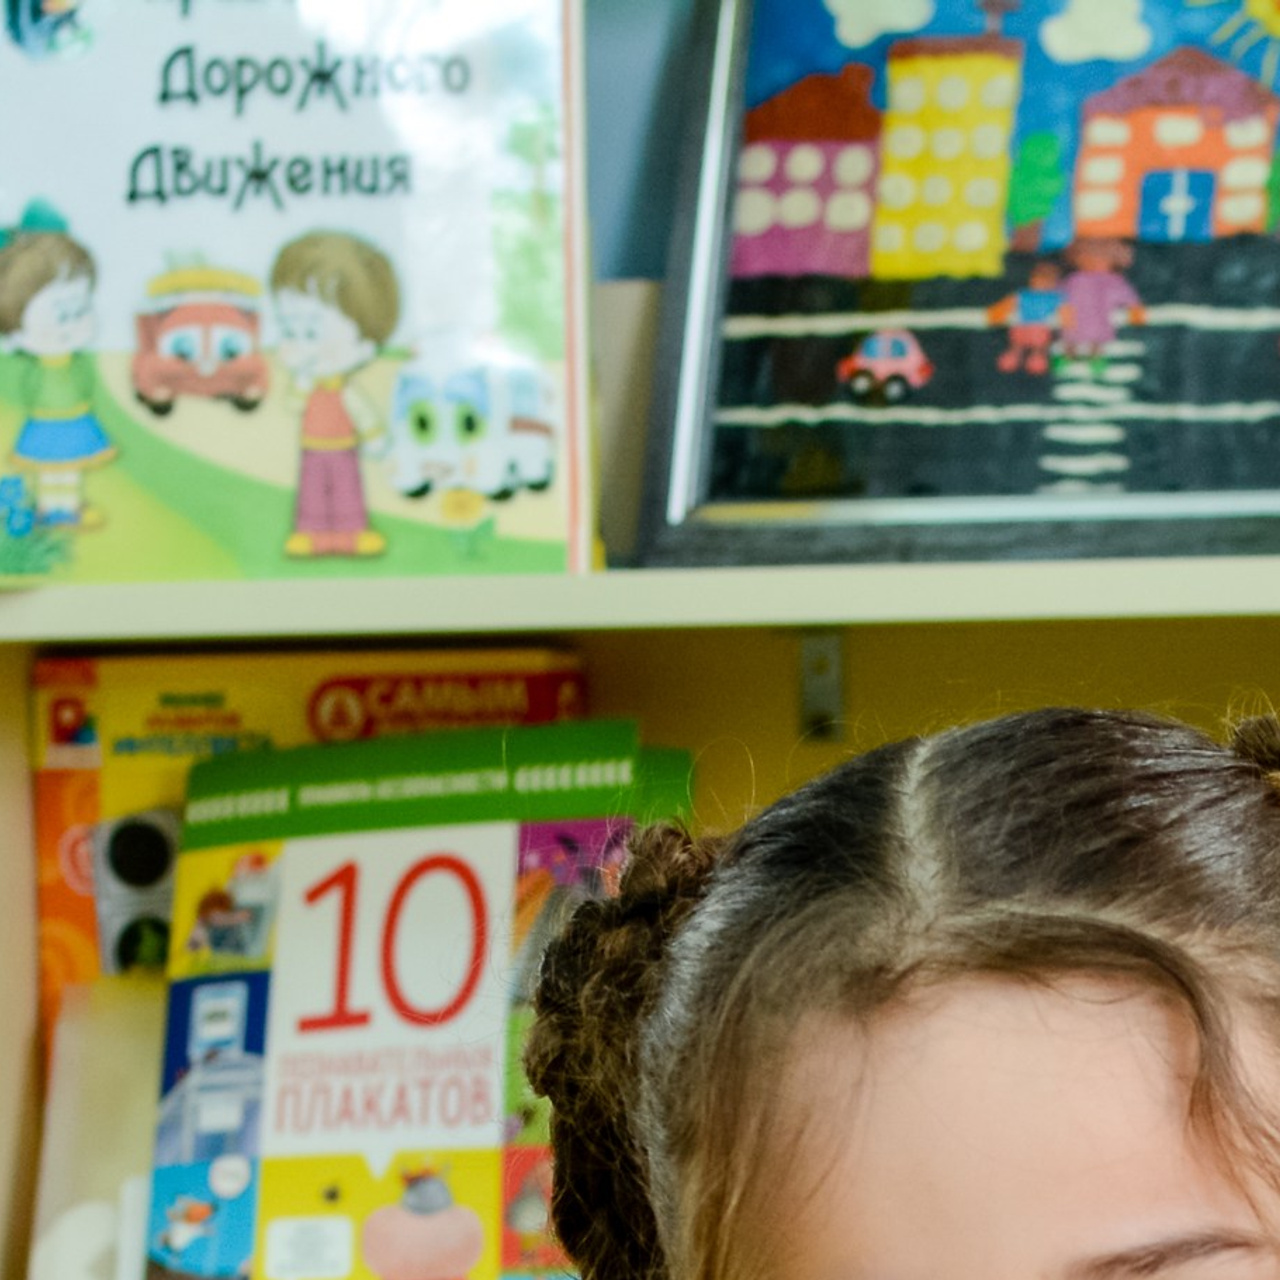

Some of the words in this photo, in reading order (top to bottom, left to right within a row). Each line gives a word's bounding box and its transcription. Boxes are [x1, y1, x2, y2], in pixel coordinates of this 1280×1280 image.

[158, 39, 472, 116] Дорожного
[125, 139, 412, 211] Движения
[294, 852, 489, 1035] 10
[273, 1073, 494, 1136] ПЛАКАТОВ
